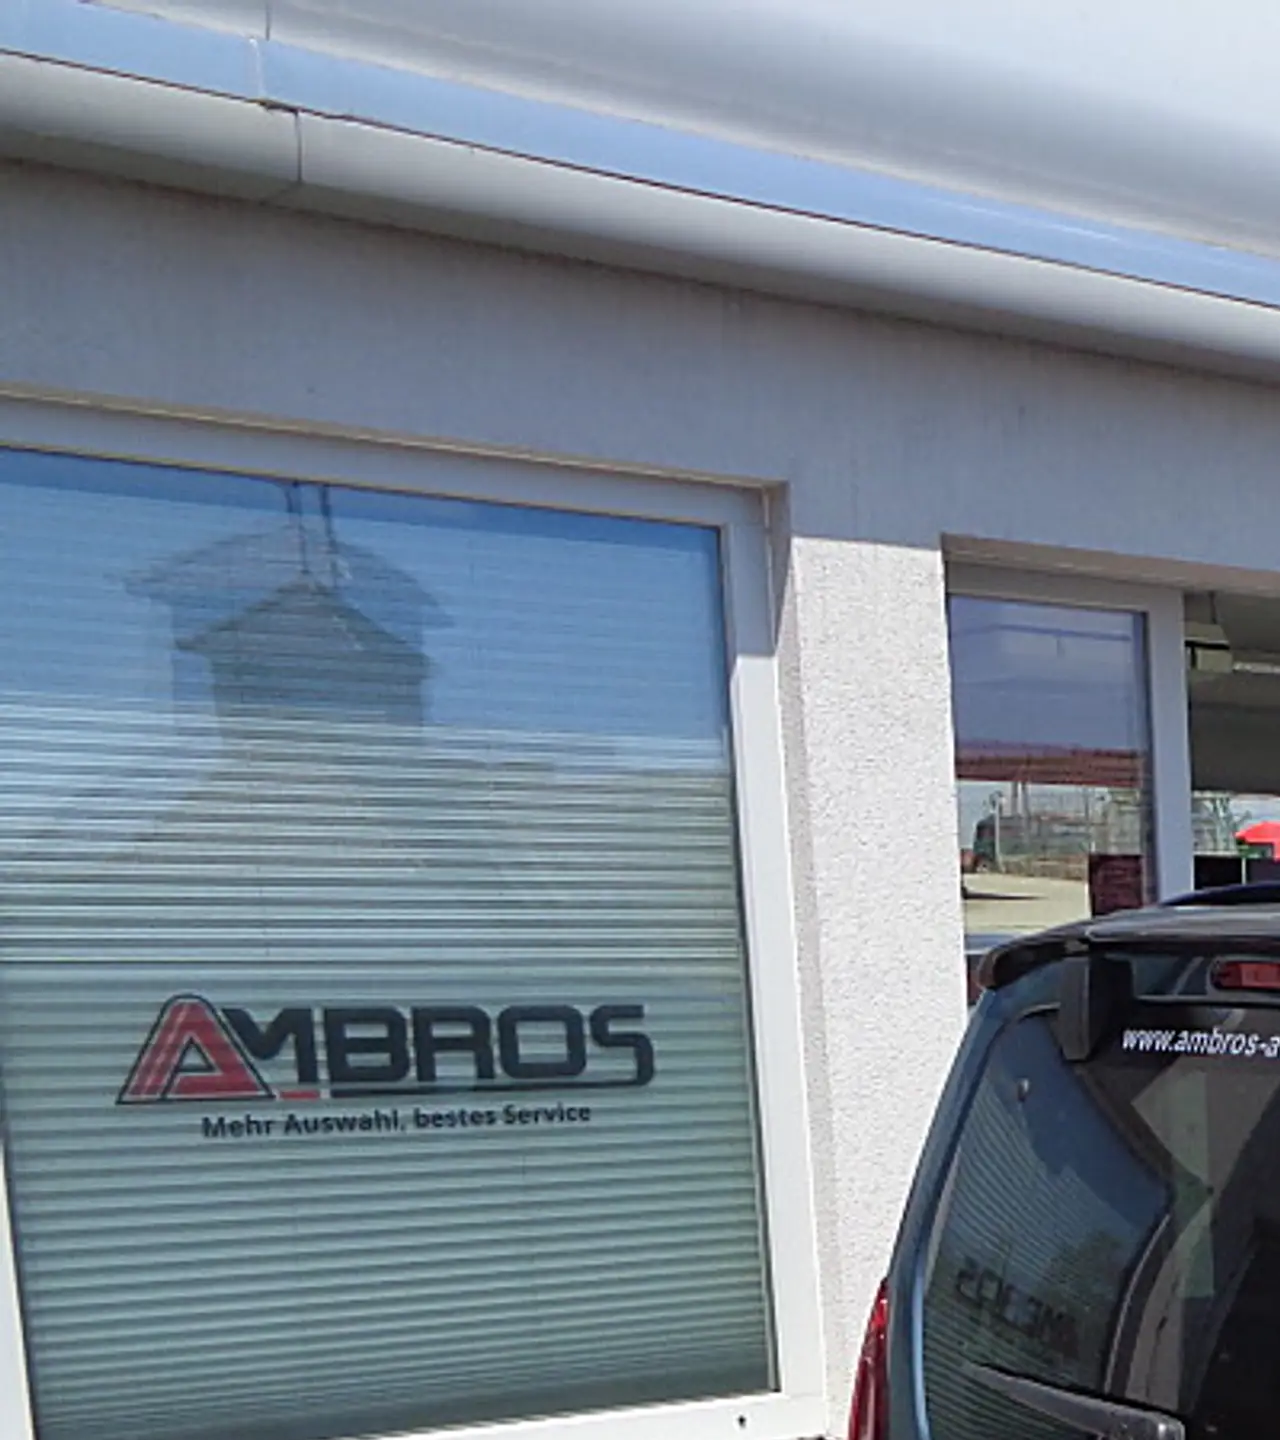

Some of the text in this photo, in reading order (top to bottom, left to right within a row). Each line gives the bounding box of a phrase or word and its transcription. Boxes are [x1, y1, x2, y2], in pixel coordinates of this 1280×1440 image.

[115, 993, 655, 1105] AMBROS
[202, 1103, 593, 1139] Mehr Auswahl, bestes Service
